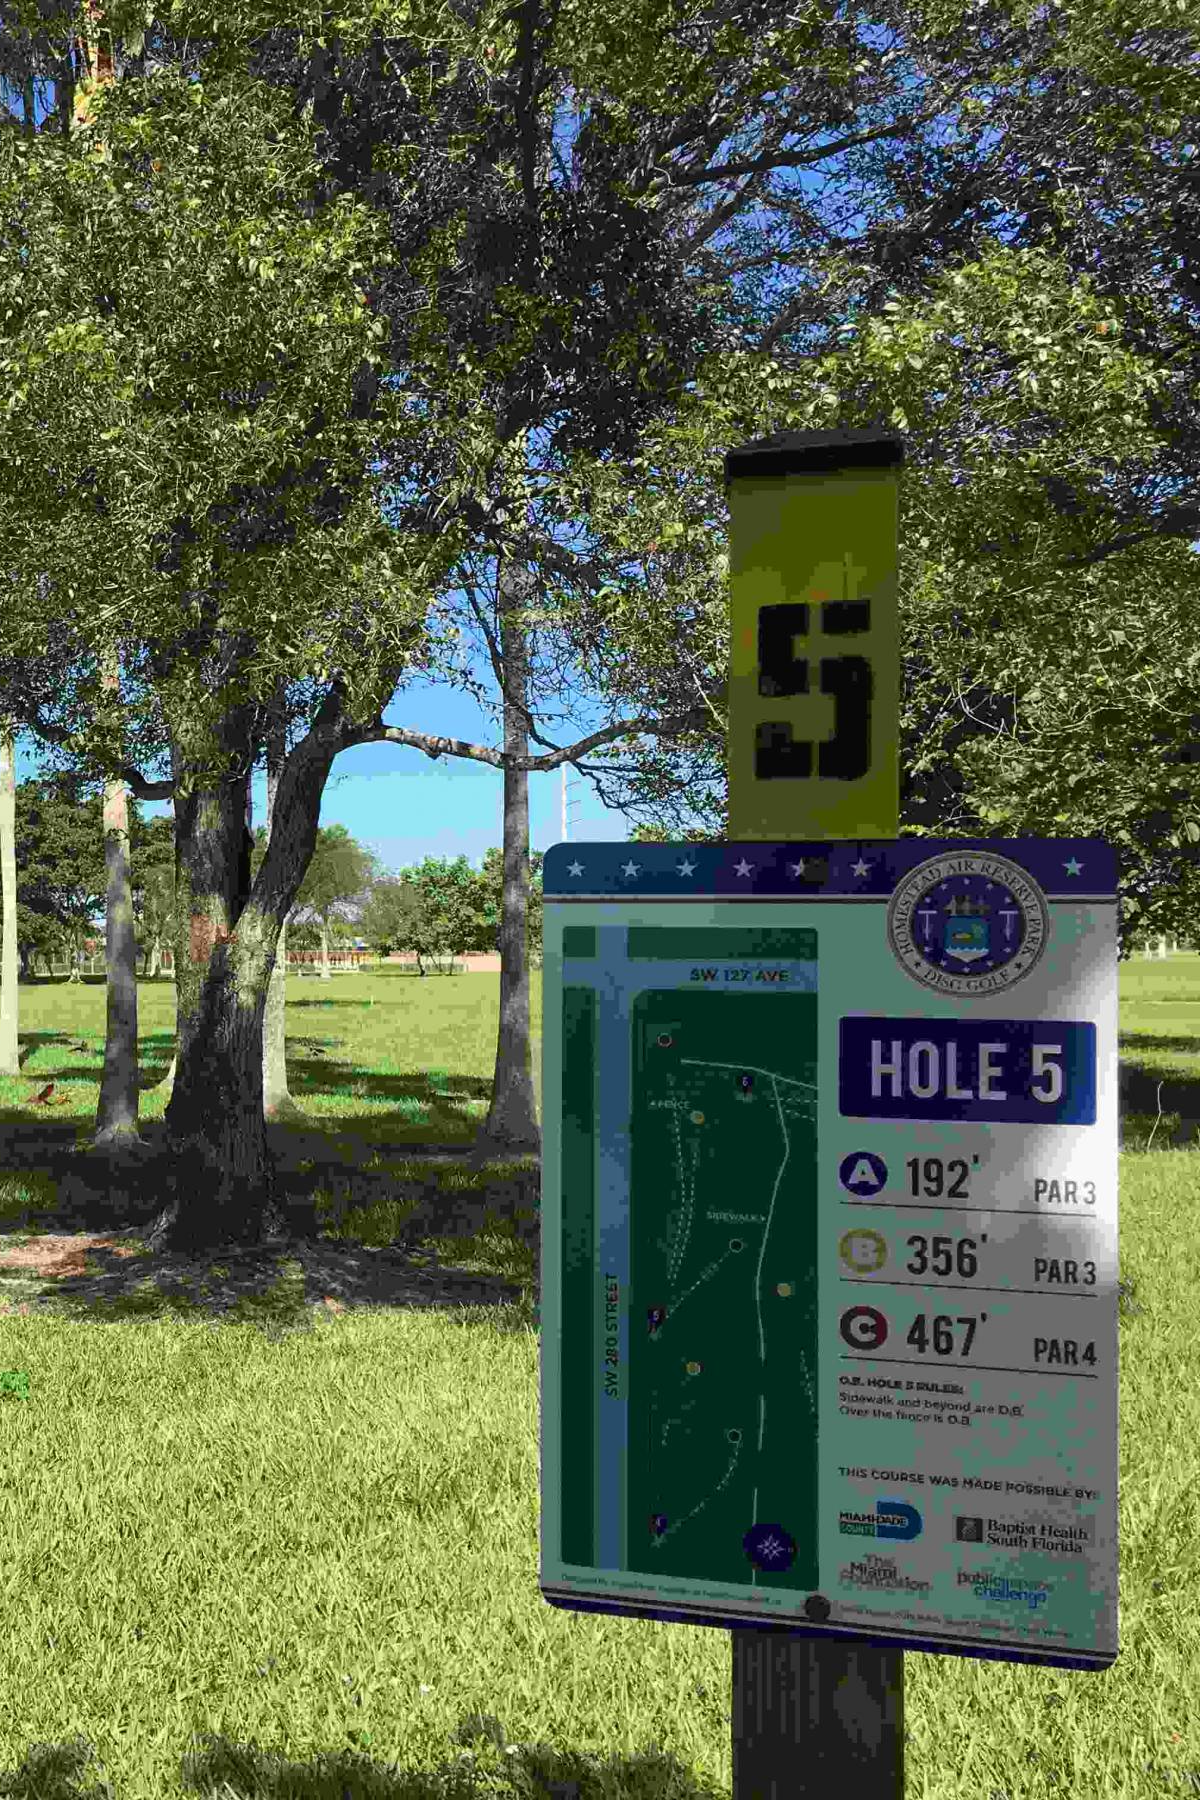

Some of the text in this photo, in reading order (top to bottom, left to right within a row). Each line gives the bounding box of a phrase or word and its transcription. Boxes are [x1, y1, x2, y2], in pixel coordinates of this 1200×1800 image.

[755, 600, 871, 780] 5
[894, 859, 1042, 956] HOMESTEAD AIR RESERVE PARK
[690, 968, 790, 981] SW 127 AVE
[924, 967, 1010, 991] DISC GOLF
[871, 1040, 1063, 1103] HOLE 5
[848, 1158, 880, 1185] A
[1034, 1178, 1096, 1204] PAR 3
[906, 1233, 987, 1278] 356'
[1034, 1257, 1096, 1285] PAR 3
[605, 1272, 619, 1396] SW 280 STREET
[906, 1312, 987, 1357] 467'
[1034, 1337, 1097, 1366] PAR 4
[867, 1378, 901, 1389] HOLE
[839, 1392, 894, 1406] Sidewalk
[897, 1396, 920, 1408] and
[924, 1399, 971, 1412] beyond
[975, 1405, 994, 1414] are
[839, 1405, 869, 1416] Over
[873, 1408, 892, 1419] the
[934, 1413, 943, 1423] is
[838, 1467, 1097, 1500] THIS COURSE WAS MADE POSSIBLE BY:
[987, 1532, 1083, 1553] South Florida
[988, 1519, 1088, 1540] Baptist Health
[850, 1561, 897, 1579] Miami
